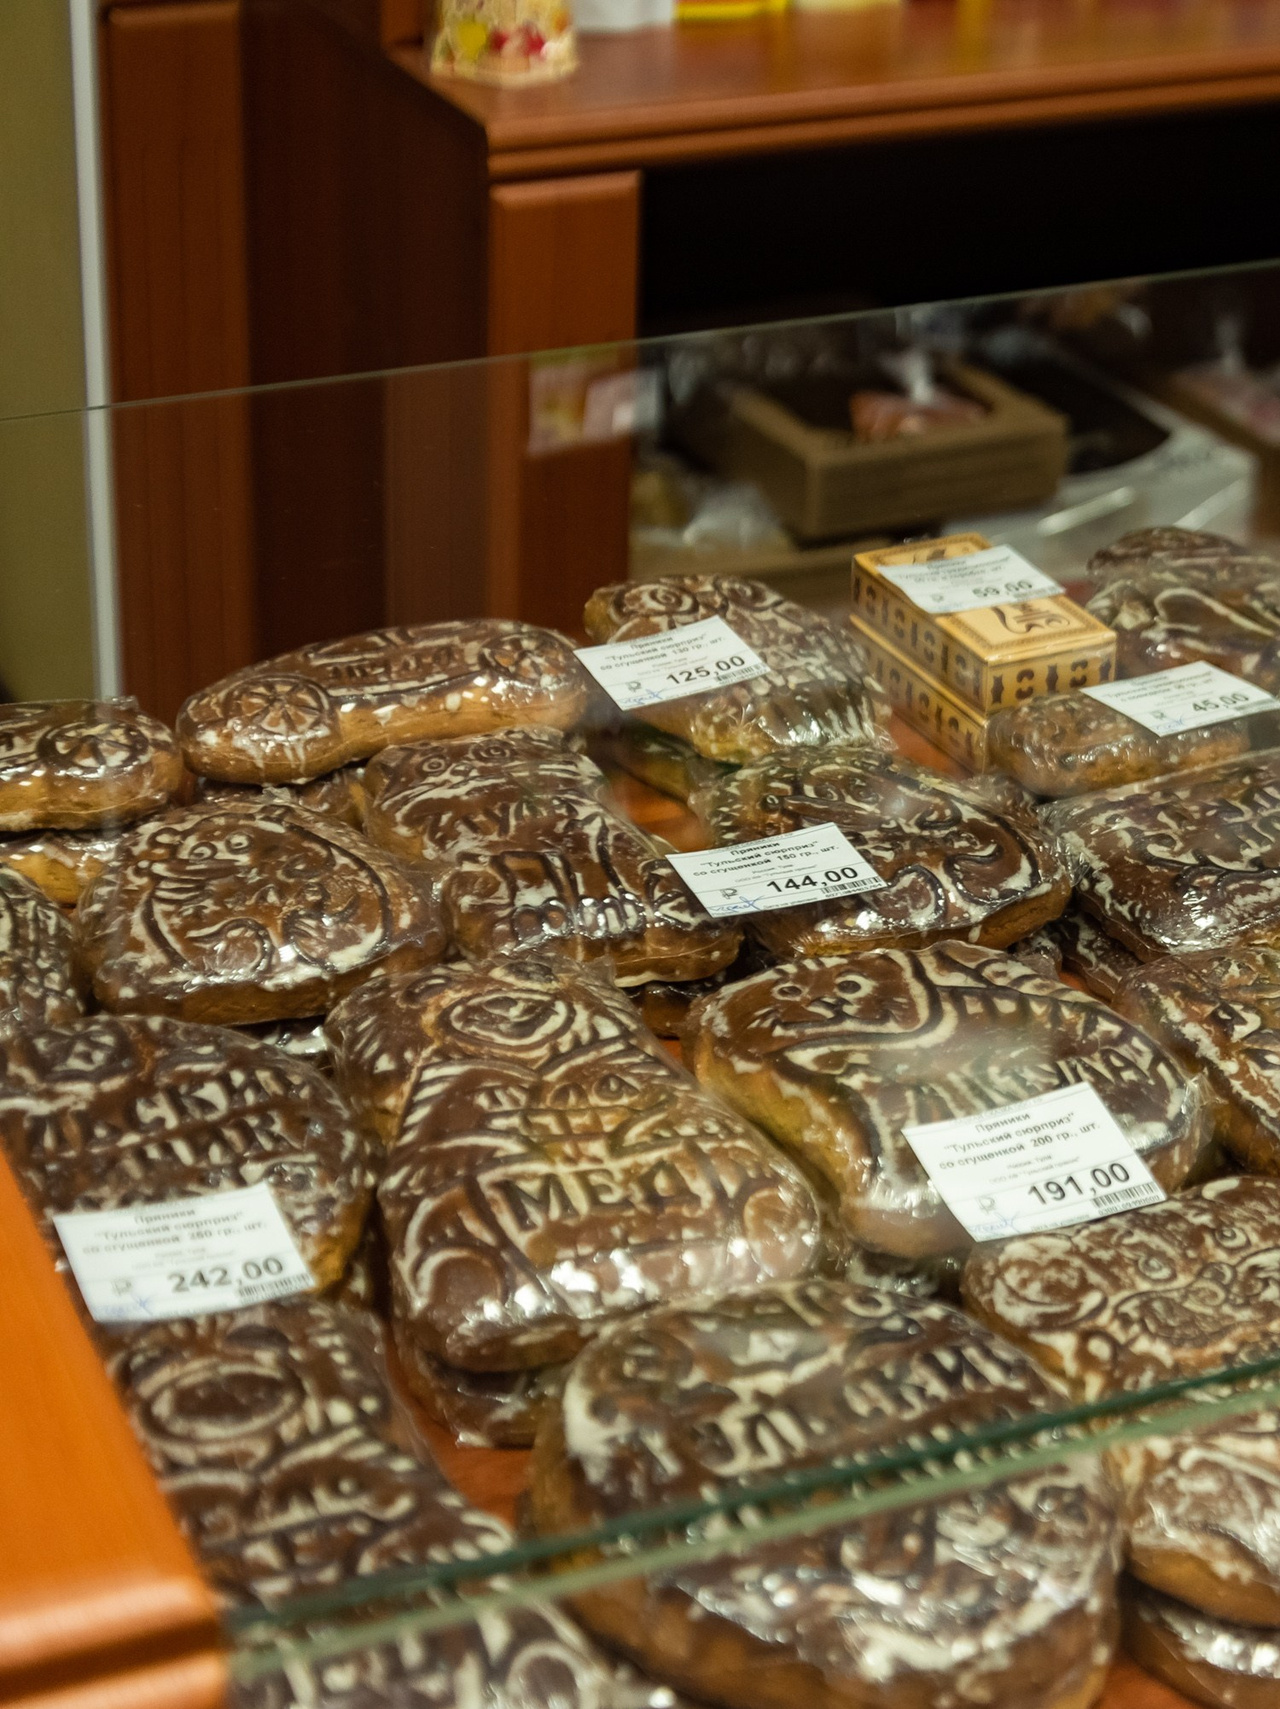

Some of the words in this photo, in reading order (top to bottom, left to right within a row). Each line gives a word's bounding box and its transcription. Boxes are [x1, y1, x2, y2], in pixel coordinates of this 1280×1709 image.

[666, 655, 745, 684] 125,00
[1192, 692, 1249, 711] 45,00
[700, 852, 762, 867] "Тульский
[763, 840, 817, 856] сюрприз"
[729, 842, 780, 855] Пряники
[709, 858, 771, 873] сгущенкой
[766, 866, 858, 892] 144,00
[946, 1131, 1012, 1152] "Тульский
[1014, 1112, 1073, 1136] сюрприз"
[974, 1112, 1030, 1132] Пряники
[957, 1142, 1025, 1165] сгущенкой
[1030, 1134, 1053, 1147] 200
[1078, 1122, 1095, 1133] шт.
[1028, 1162, 1129, 1203] 191,00
[169, 1256, 283, 1292] 242,00
